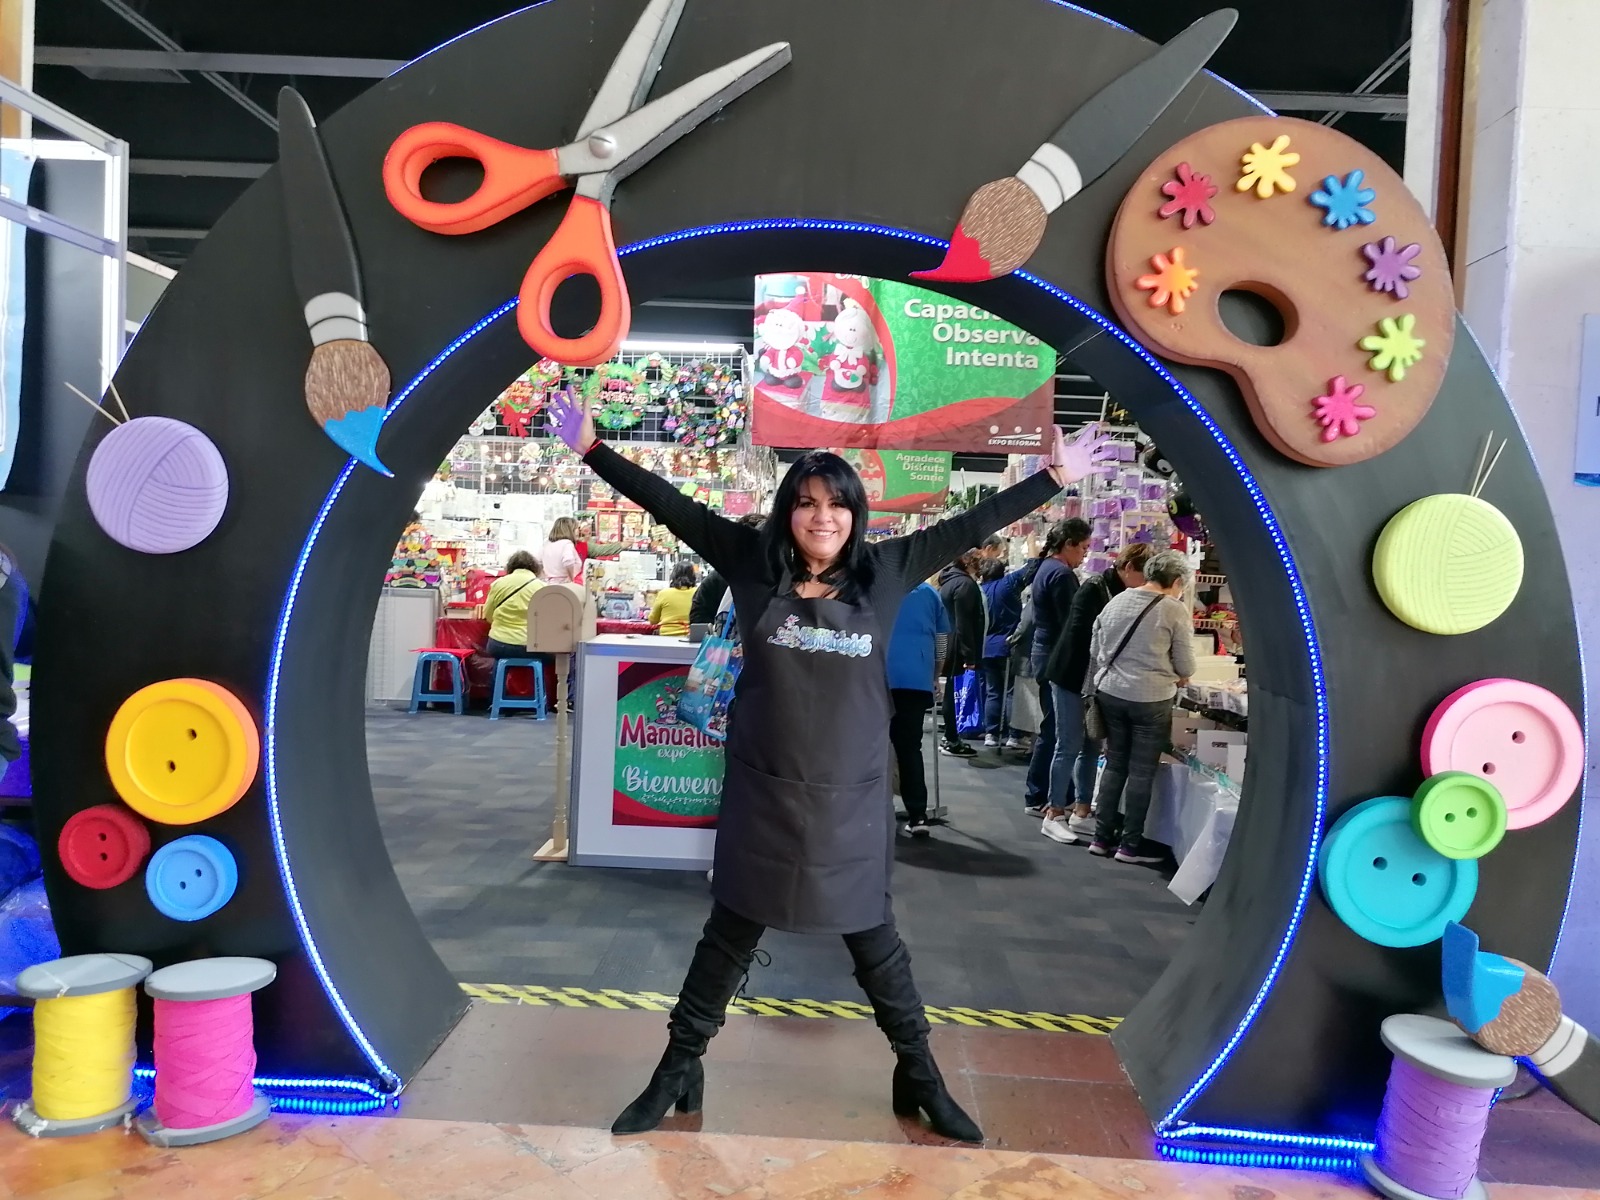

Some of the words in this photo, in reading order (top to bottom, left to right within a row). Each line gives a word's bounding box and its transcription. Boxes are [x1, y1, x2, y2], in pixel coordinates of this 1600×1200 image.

[932, 323, 1039, 345] Observa
[946, 347, 1038, 368] Intenta
[896, 453, 945, 463] Agradece
[902, 462, 944, 472] Disfruta
[658, 748, 688, 762] expo
